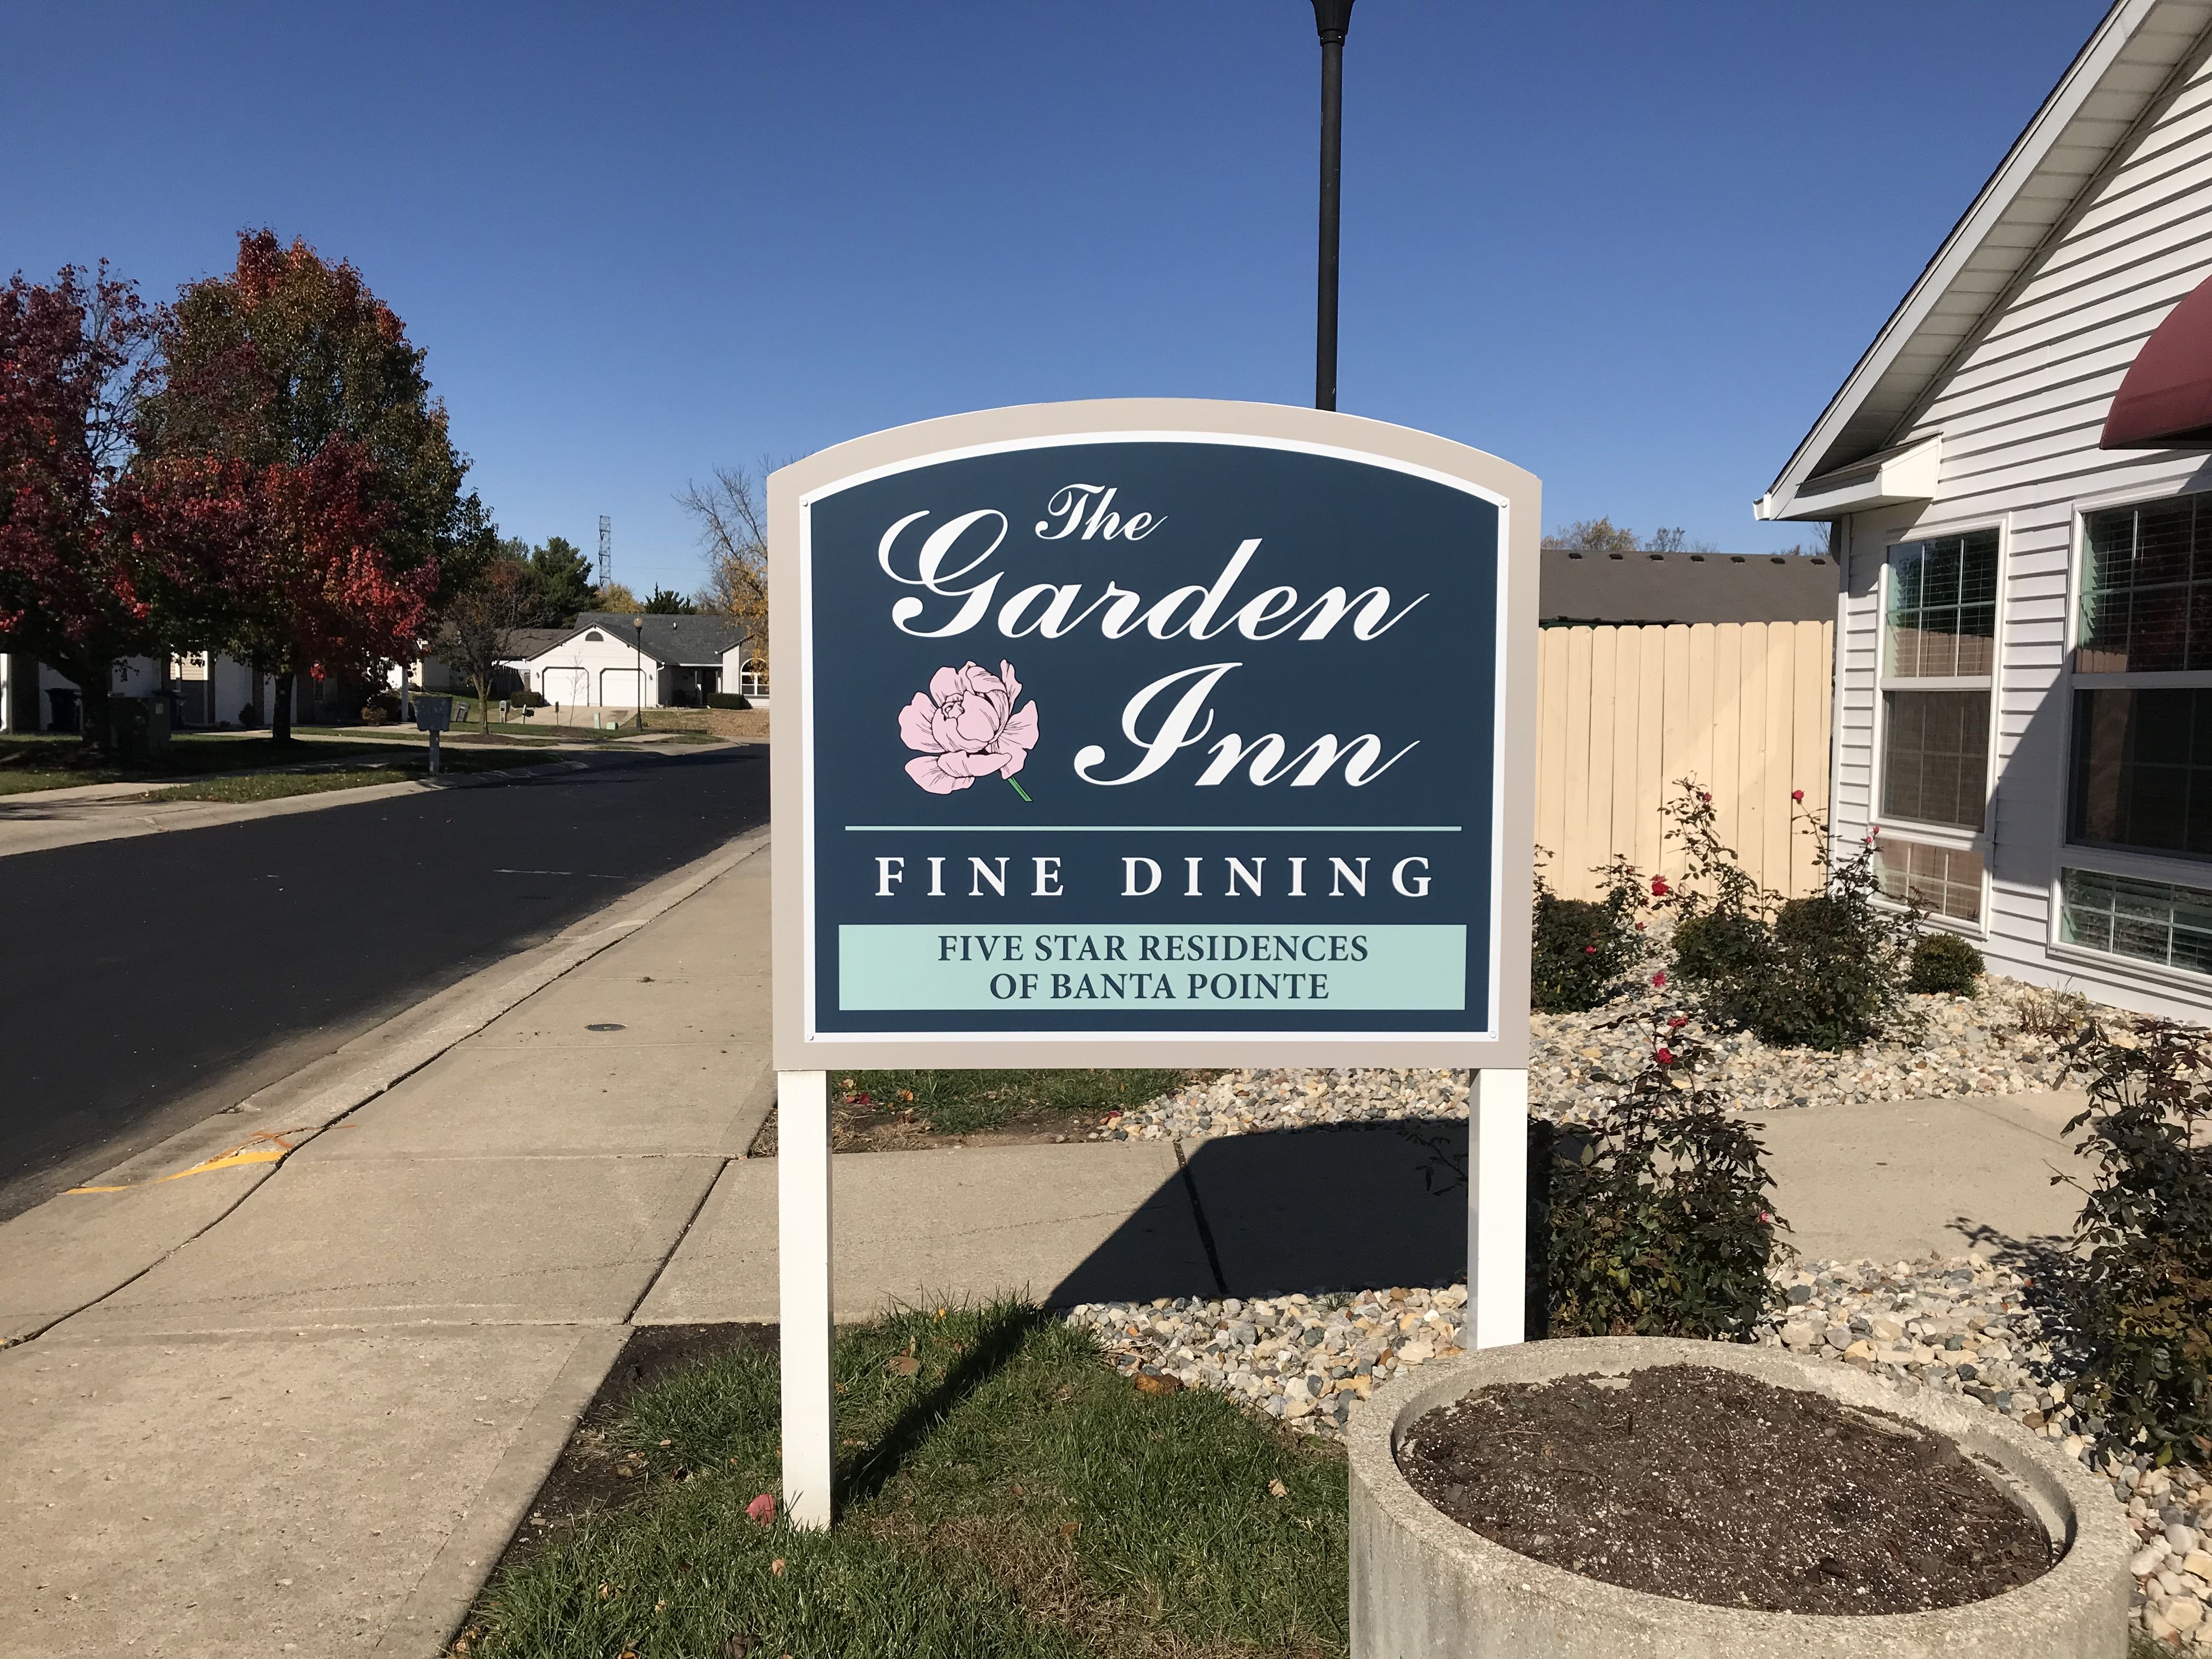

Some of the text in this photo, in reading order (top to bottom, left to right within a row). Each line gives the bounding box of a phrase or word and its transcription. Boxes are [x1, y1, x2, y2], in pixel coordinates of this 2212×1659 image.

[1035, 483, 1169, 541] The
[878, 509, 1431, 641] Garden
[1073, 662, 1421, 787] Inn
[874, 856, 1432, 897] FINE DINING
[938, 934, 1368, 962] FIVE STAR RESIDENCES
[990, 973, 1329, 1000] OF BANTA POINTE
